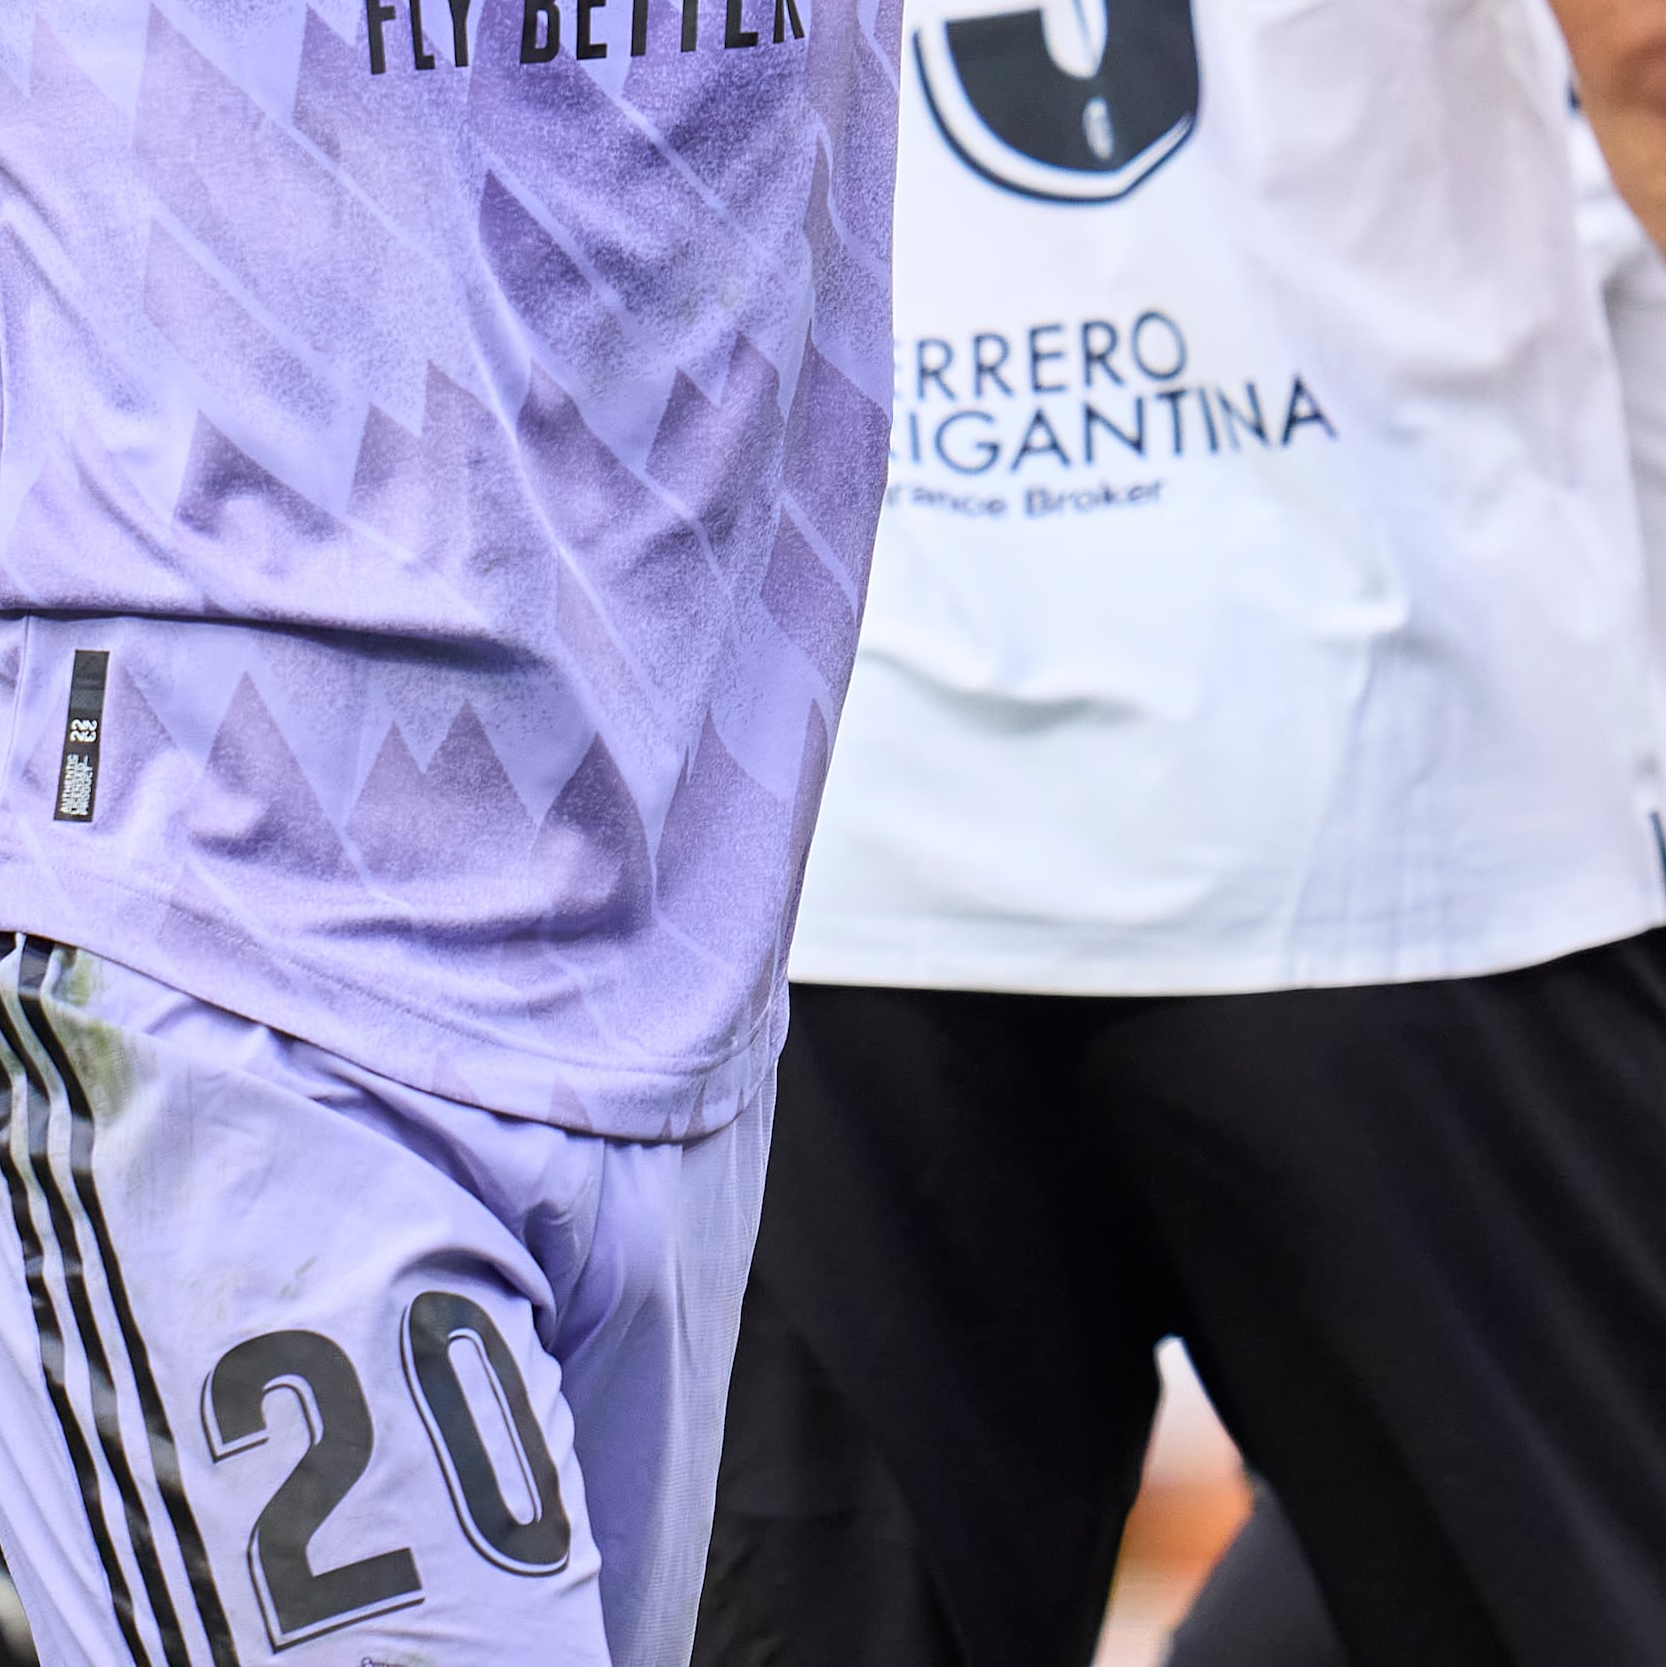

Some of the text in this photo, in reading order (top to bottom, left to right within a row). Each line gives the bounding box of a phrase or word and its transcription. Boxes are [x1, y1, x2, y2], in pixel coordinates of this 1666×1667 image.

[895, 308, 1188, 403] RRERO
[890, 373, 1339, 476] IGANTINA
[1023, 477, 1167, 518] Broker
[200, 1290, 572, 1654] 20
